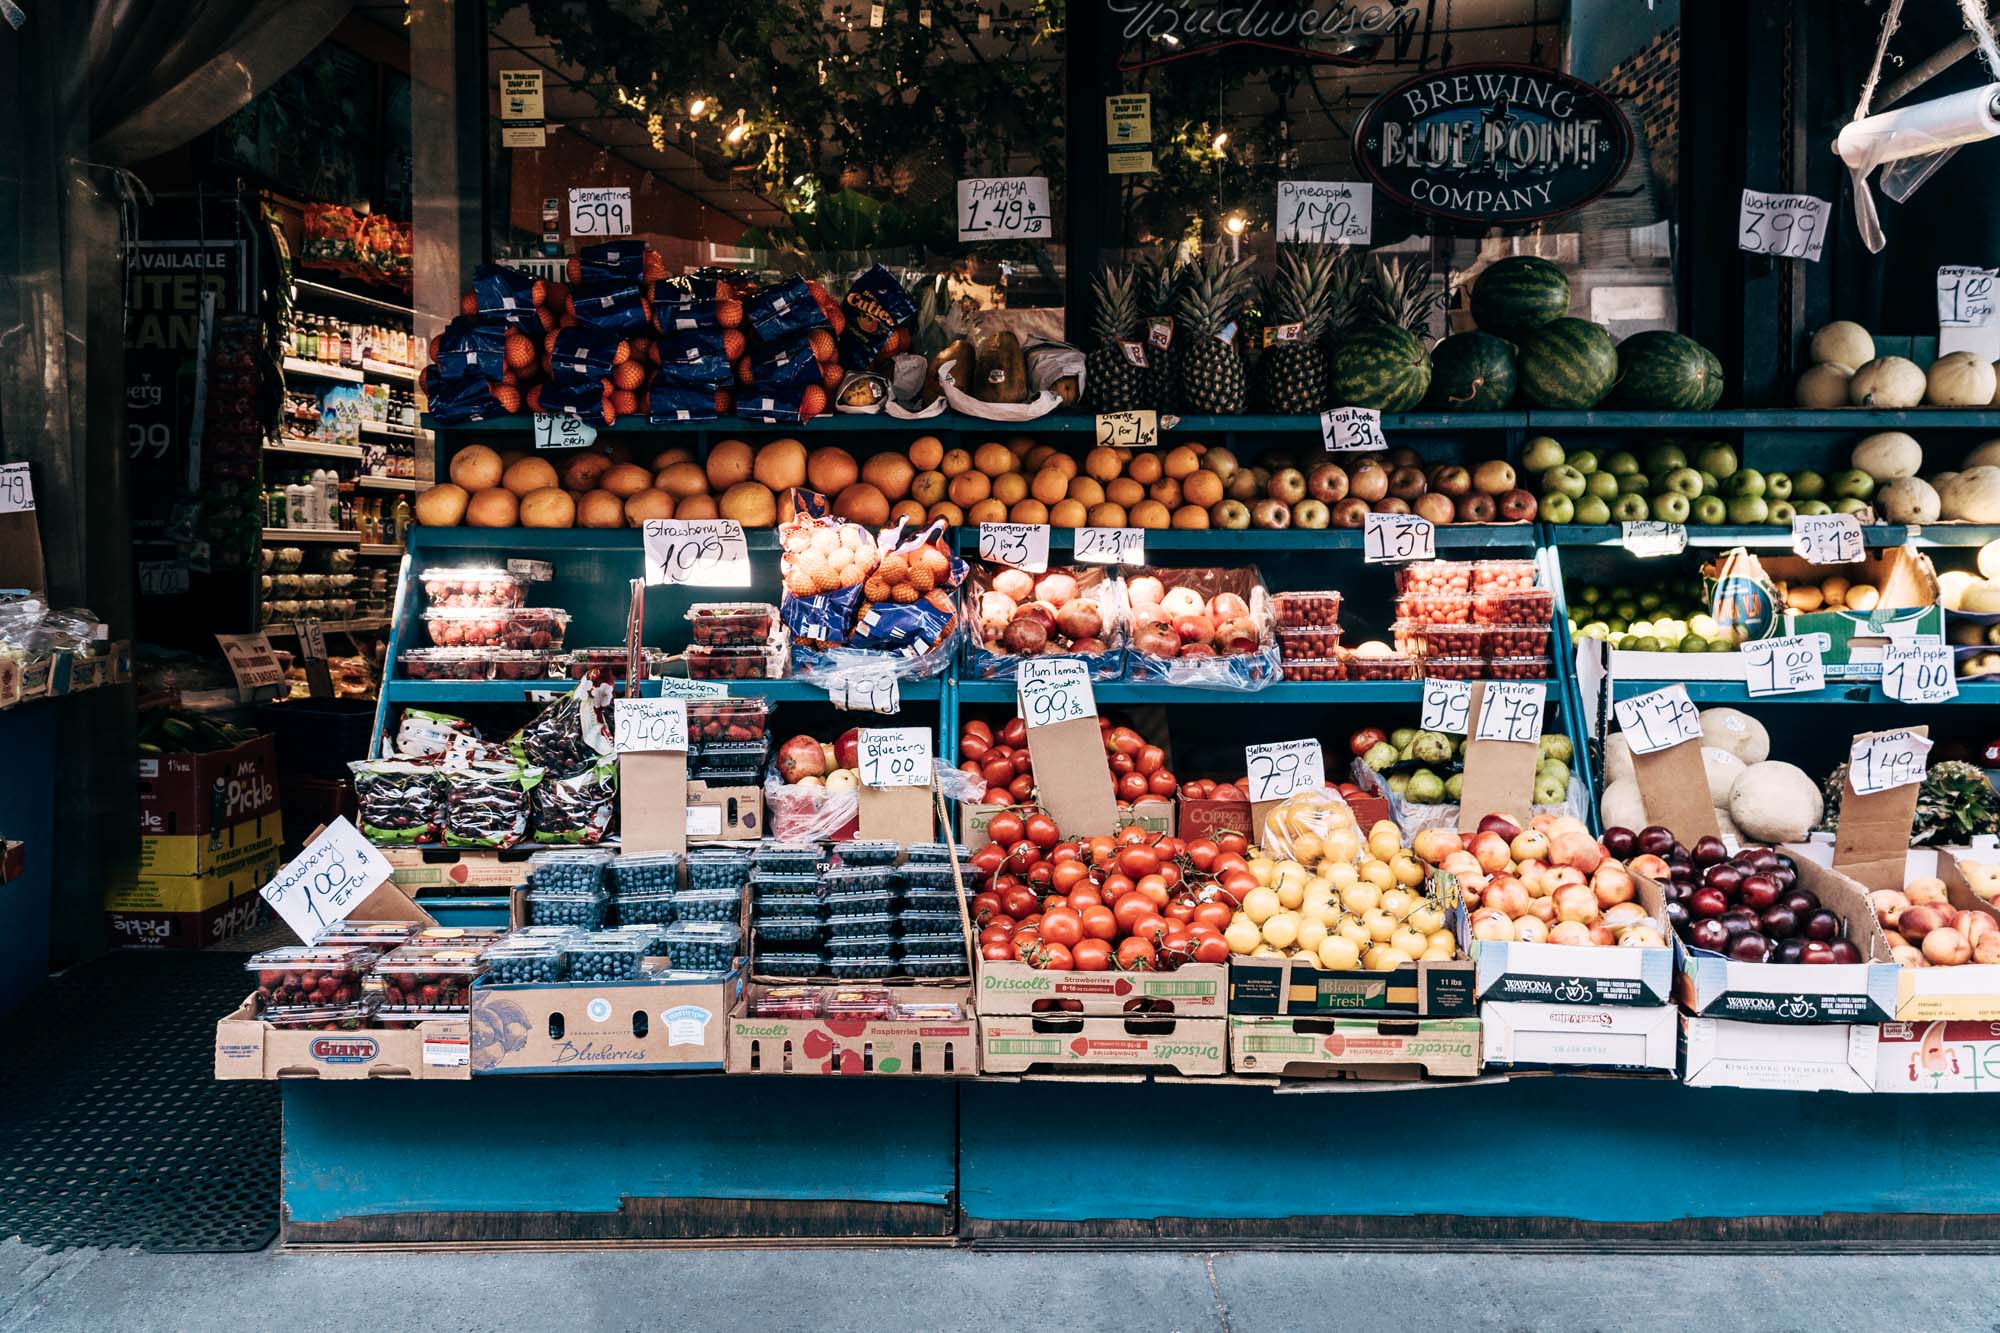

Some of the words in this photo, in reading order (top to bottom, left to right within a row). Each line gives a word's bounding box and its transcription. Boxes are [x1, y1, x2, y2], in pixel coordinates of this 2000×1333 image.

[1403, 74, 1577, 118] BREWING
[1382, 120, 1473, 168] BLUE
[1410, 178, 1554, 213] COMPANY
[575, 203, 624, 234] 5.99
[960, 200, 1023, 232] 1.49
[1740, 210, 1815, 257] 3.99
[129, 252, 227, 269] AVAILABLE
[1326, 422, 1373, 449] 1.39
[1025, 661, 1051, 678] Plum
[224, 776, 273, 817] Pickle
[112, 919, 170, 937] Pickle
[984, 976, 1051, 990] Driscoll's
[1063, 976, 1111, 984] Strawberries
[1324, 981, 1369, 994] Bloom
[1505, 980, 1552, 990] WAWONA
[1329, 994, 1365, 1007] Fresh
[1726, 997, 1776, 1008] WAWONA
[735, 1023, 789, 1037] Driscoll's
[871, 1027, 918, 1037] Raspberries
[314, 1041, 373, 1057] GIANT
[551, 1040, 646, 1063] Blueberries
[1152, 1045, 1219, 1060] Driscoll's
[1405, 1042, 1473, 1058] Driscoll's
